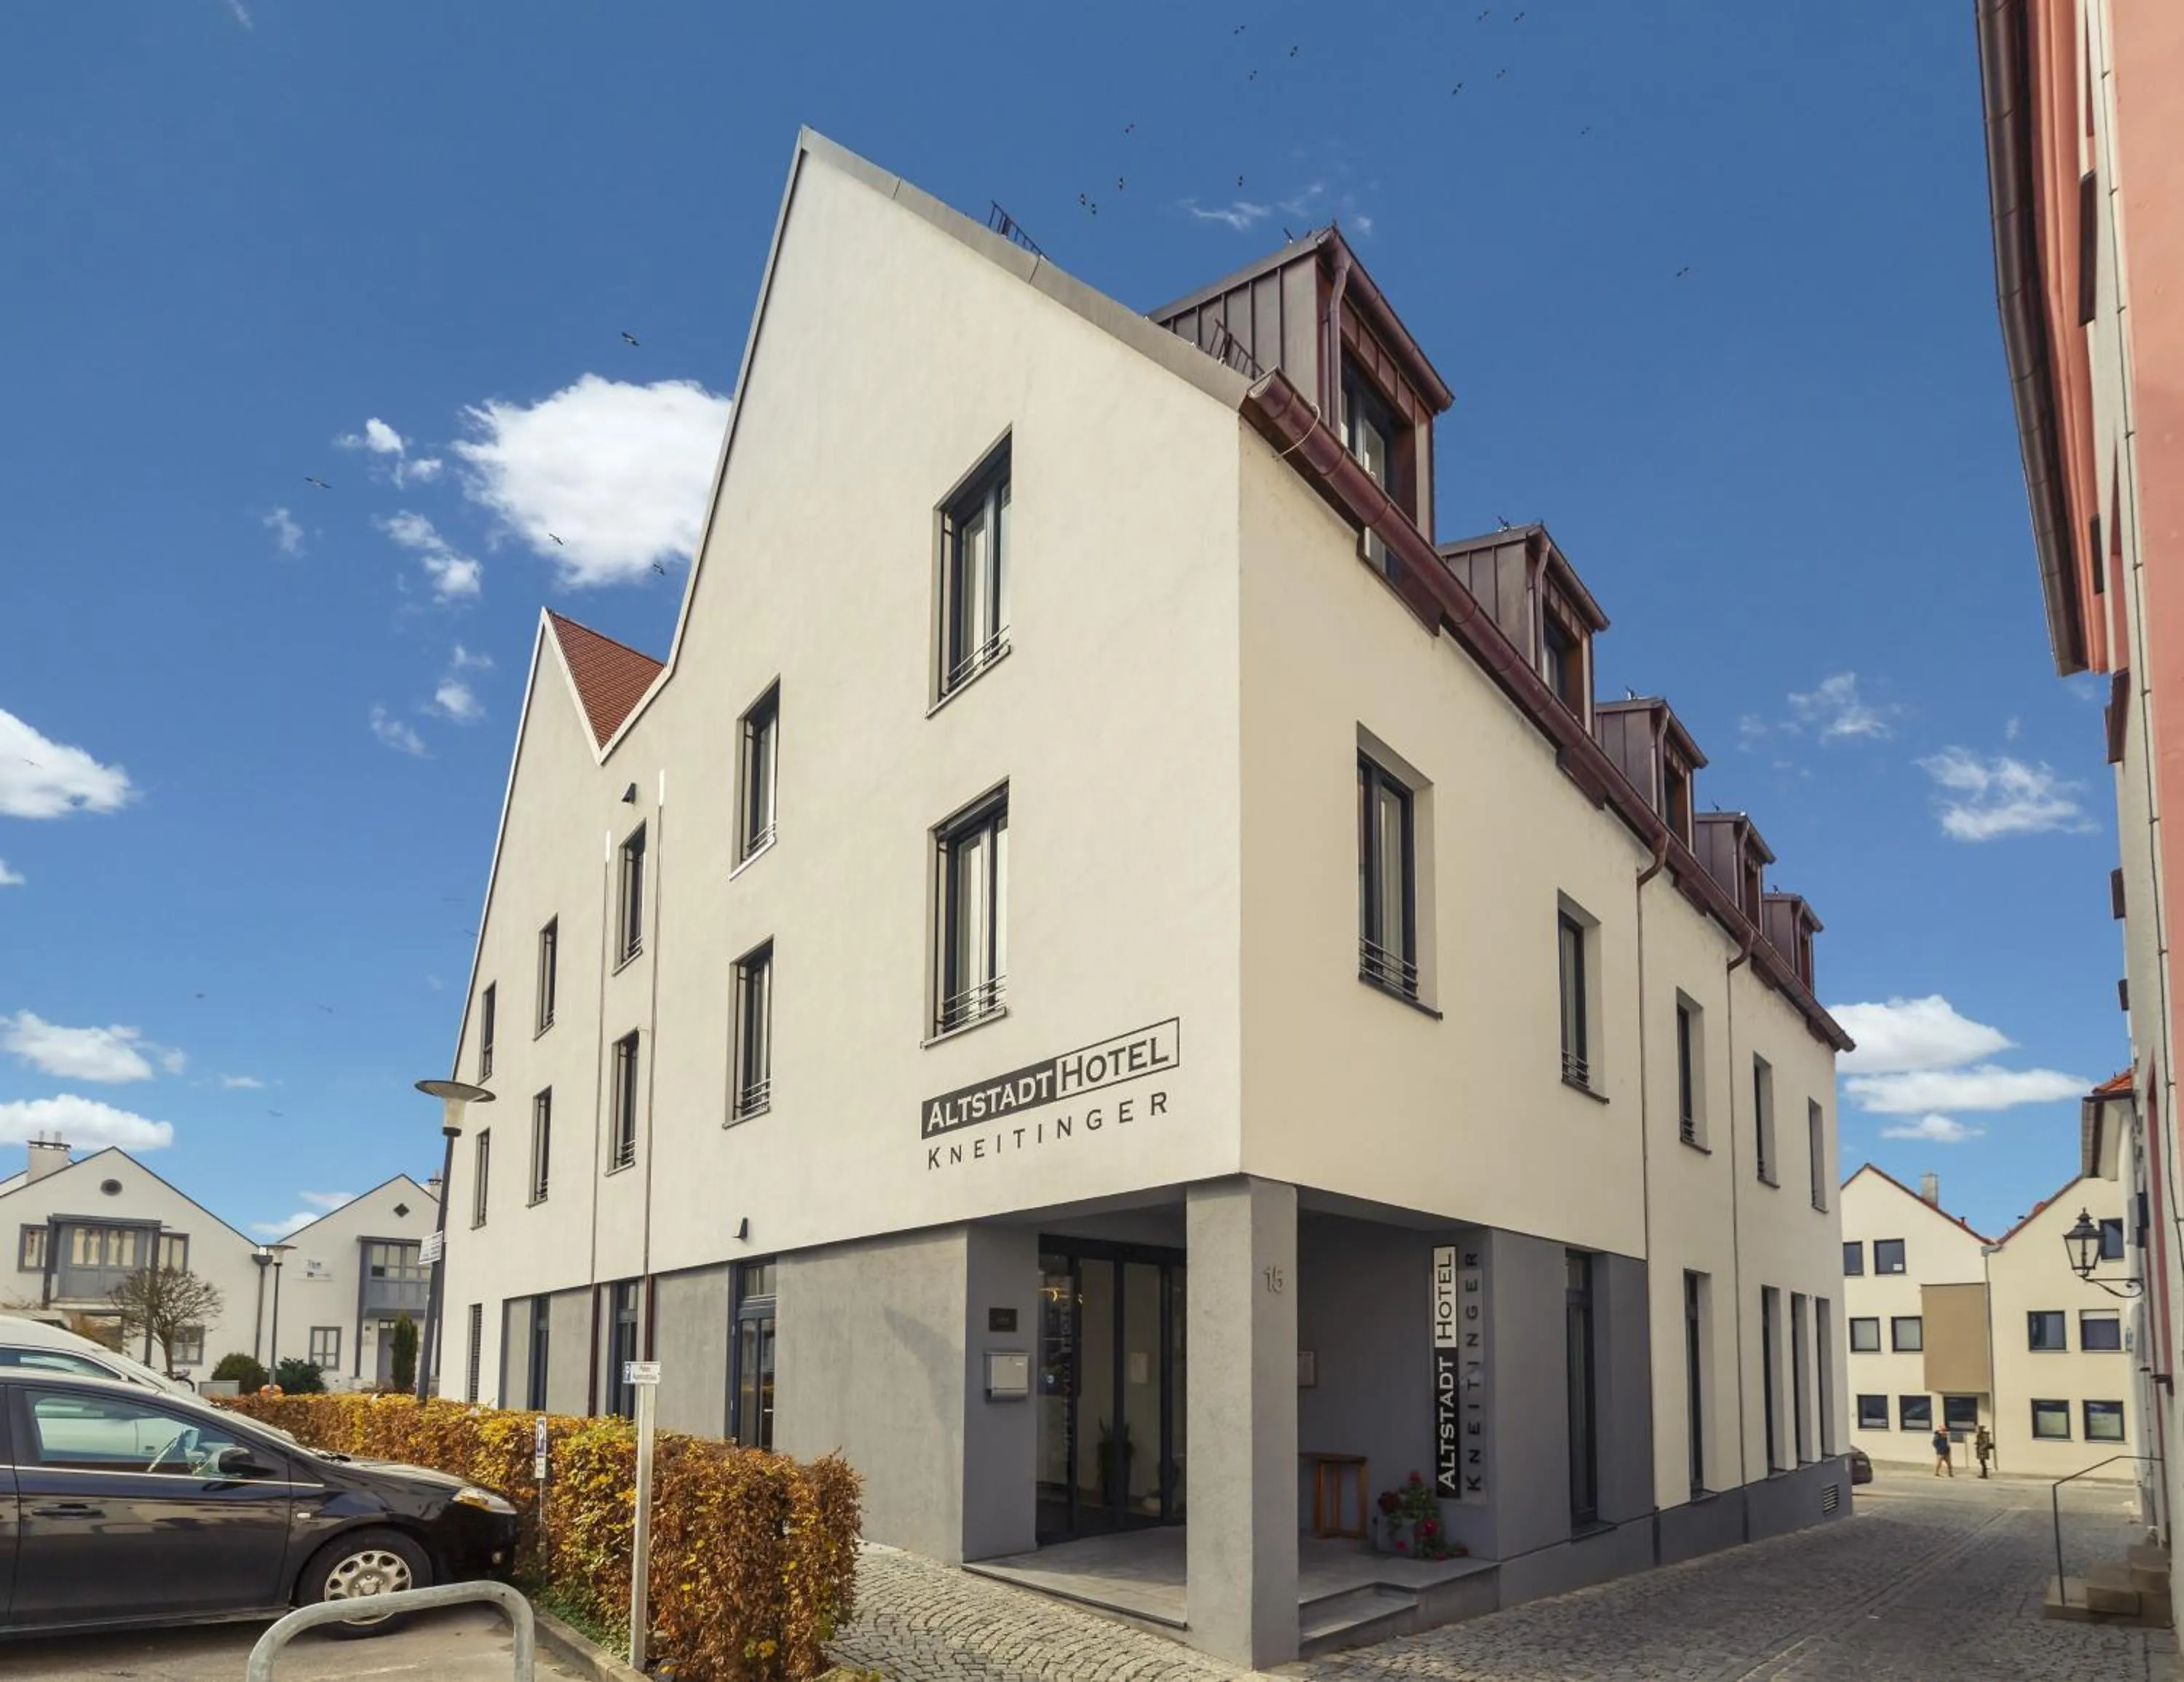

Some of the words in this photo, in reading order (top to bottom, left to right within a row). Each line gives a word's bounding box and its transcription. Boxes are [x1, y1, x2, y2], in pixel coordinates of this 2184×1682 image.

[927, 1070, 1053, 1132] ALTSTADT
[1061, 1036, 1169, 1091] HOTEL
[927, 1091, 1168, 1171] KNEITINGER
[1436, 1252, 1452, 1341] HOTEL
[1465, 1252, 1481, 1492] KNEITINGER
[1438, 1357, 1456, 1490] ALTSTADT
